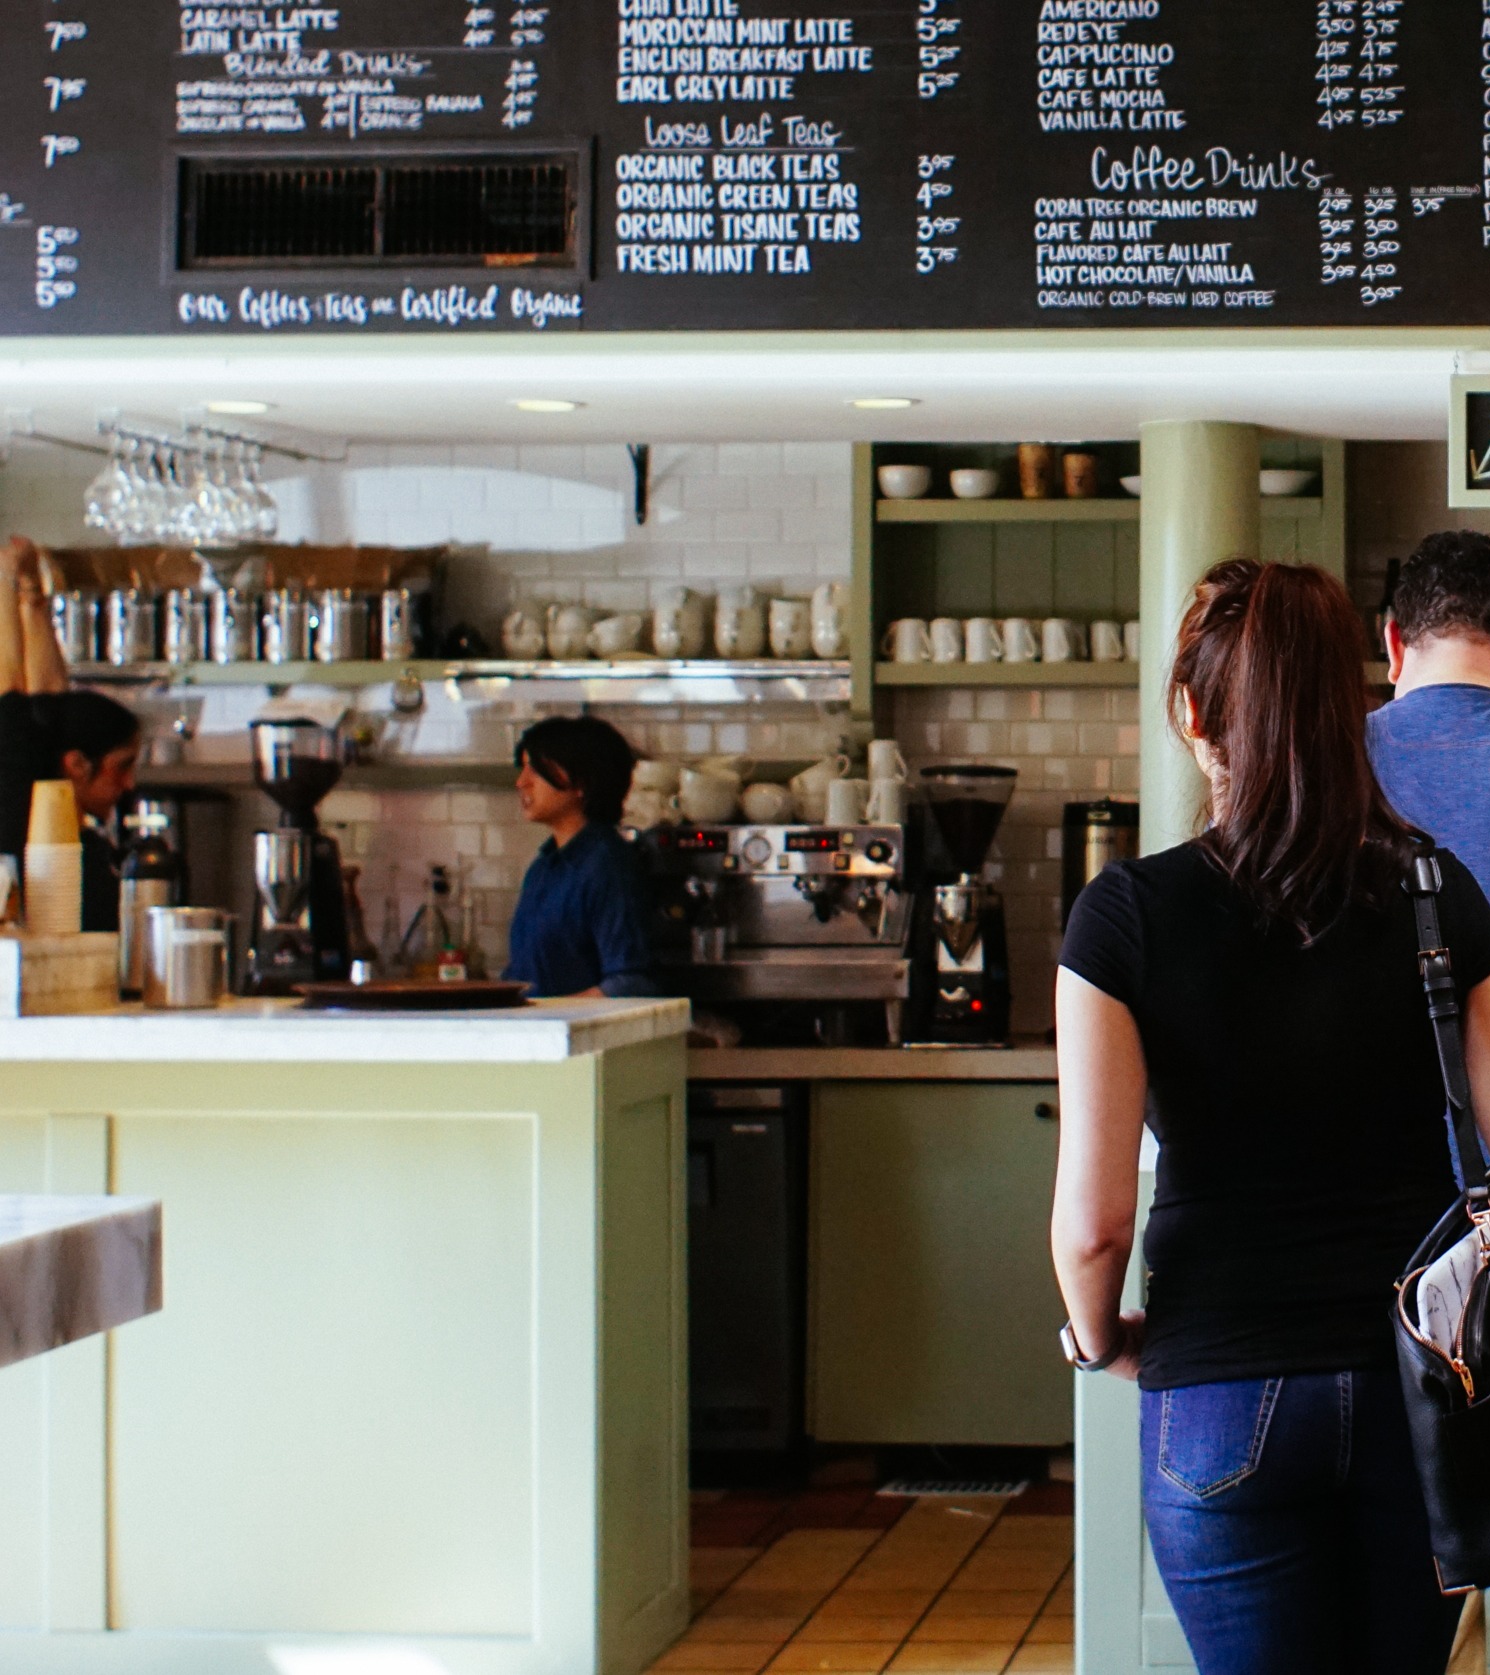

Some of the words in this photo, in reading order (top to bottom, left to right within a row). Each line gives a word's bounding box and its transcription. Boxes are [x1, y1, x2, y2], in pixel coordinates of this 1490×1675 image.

[180, 9, 271, 31] CARAMEL
[276, 9, 338, 30] LATTE
[1040, 0, 1159, 20] AMERICANO
[182, 30, 230, 54] LATIN
[238, 30, 301, 53] LATTE
[619, 17, 733, 45] MOROCCAN
[737, 19, 789, 44] MINT
[795, 19, 851, 43] LATTE
[339, 50, 430, 76] Drinks
[618, 47, 703, 74] ENGLISH
[707, 46, 808, 73] BREAKFAST
[813, 47, 871, 71] LATTE
[1038, 42, 1174, 67] CAPPUCCINO
[617, 76, 671, 102] EARL
[675, 75, 728, 101] GREY
[729, 75, 793, 100] LATTE
[1038, 68, 1086, 90] CAFE
[1093, 66, 1159, 87] LATTE
[1037, 89, 1092, 109] CAFE
[1101, 89, 1165, 108] MOCHA
[645, 116, 711, 148] Loose
[721, 113, 773, 147] Leaf
[782, 116, 841, 148] Teas
[1039, 110, 1122, 131] VANILLA
[1129, 110, 1185, 130] LATTE
[616, 155, 704, 181] ORGANIC
[713, 154, 776, 180] BLACK
[782, 154, 839, 181] TEAS
[1092, 145, 1204, 191] Coffee
[1205, 148, 1333, 191] Drinks
[616, 183, 714, 209] ORGANIC
[719, 184, 790, 210] GREEN
[796, 184, 857, 209] TEAS
[1128, 200, 1202, 218] ORGANIC
[1206, 198, 1257, 217] BREW
[616, 213, 714, 240] ORGANIC
[721, 214, 799, 240] TISANE
[805, 213, 860, 241] TEAS
[1035, 222, 1081, 241] CAFE
[1090, 221, 1114, 240] AU
[1118, 220, 1156, 240] LAIT
[617, 244, 688, 273] FRESH
[693, 244, 757, 273] MINT
[764, 245, 810, 273] TEA
[1037, 244, 1118, 264] FLAVORED
[1123, 244, 1164, 263] CAFE
[1168, 244, 1190, 263] AU
[1193, 243, 1231, 262] LAIT
[1037, 266, 1076, 285] HOT
[325, 294, 367, 324] Teas
[401, 285, 498, 324] Certified
[511, 288, 582, 328] Organic
[1038, 290, 1103, 307] ORGANIC
[1192, 292, 1219, 306] ICED
[1224, 291, 1275, 306] COFFEE
